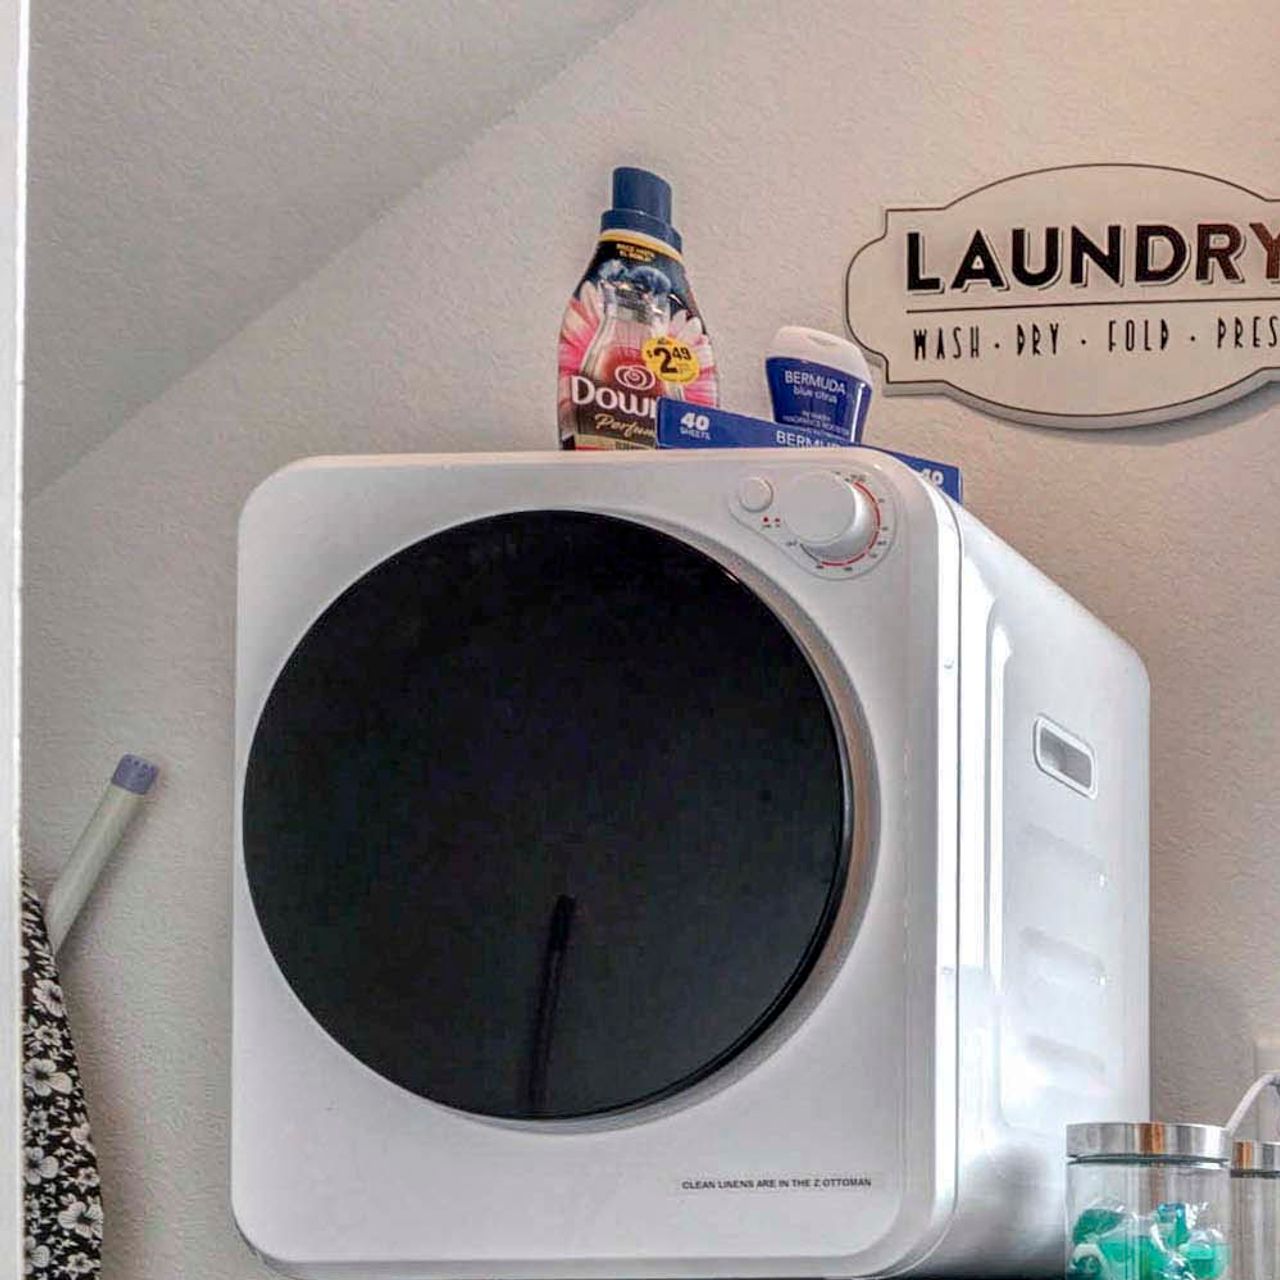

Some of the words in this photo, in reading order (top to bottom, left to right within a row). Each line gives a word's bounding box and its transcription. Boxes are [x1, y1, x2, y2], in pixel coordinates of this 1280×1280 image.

[913, 326, 981, 361] WASH
[1016, 322, 1059, 356] DRY
[1108, 318, 1169, 353] FOLD
[784, 370, 845, 395] BERMUDA
[571, 375, 657, 418] Dow
[680, 412, 710, 430] 40
[681, 1180, 716, 1190] CLEAN
[717, 1180, 754, 1189] LINENS
[756, 1179, 777, 1188] ARE
[778, 1179, 790, 1188] IN
[791, 1178, 810, 1187] THE
[821, 1178, 872, 1187] OTTOMAN
